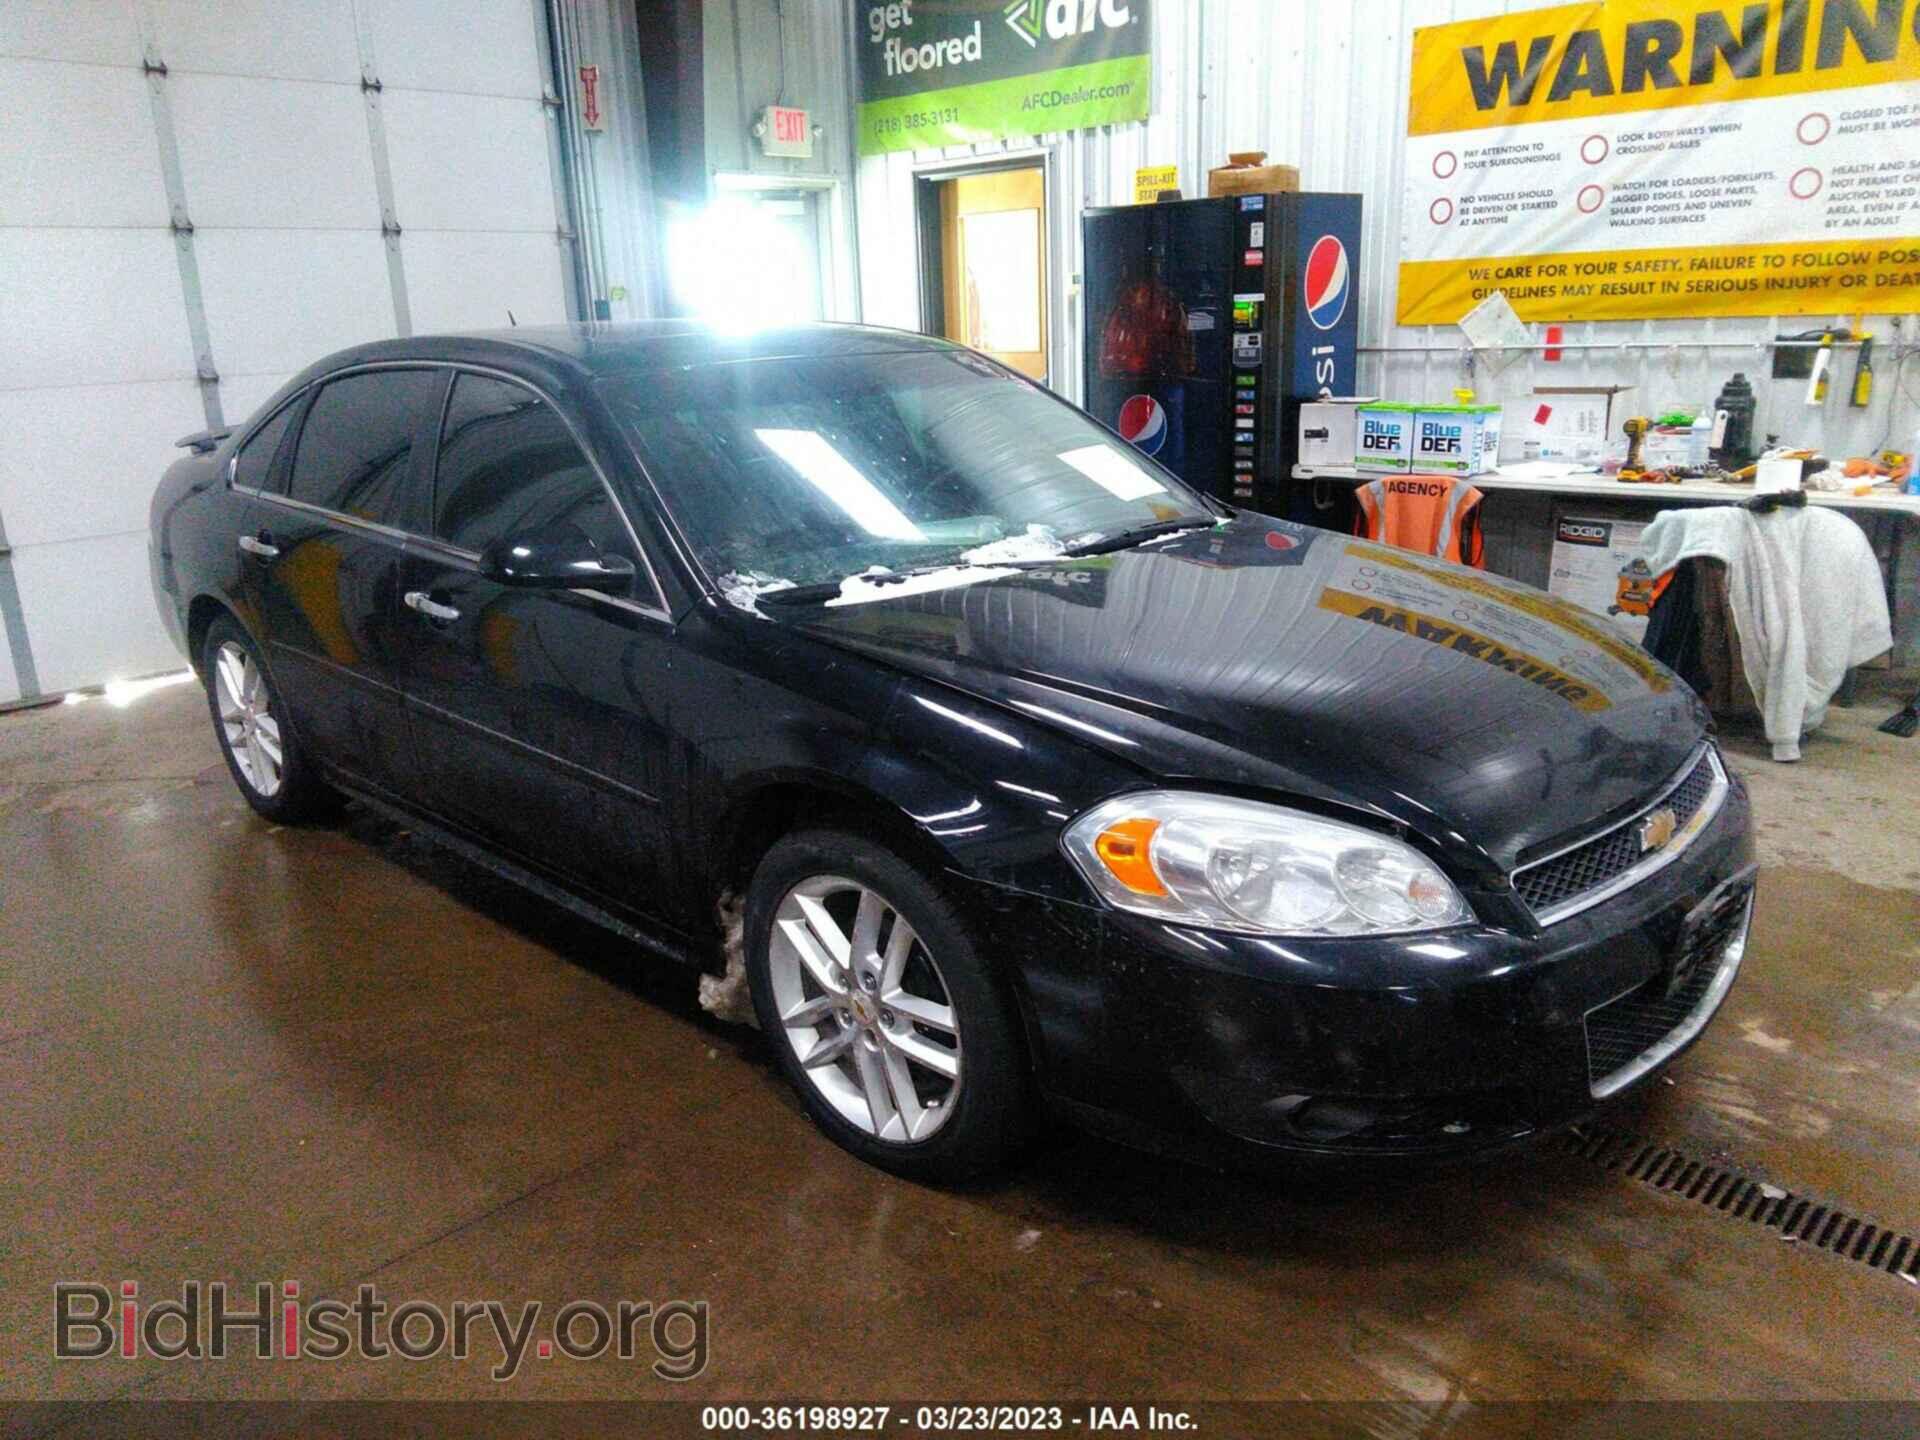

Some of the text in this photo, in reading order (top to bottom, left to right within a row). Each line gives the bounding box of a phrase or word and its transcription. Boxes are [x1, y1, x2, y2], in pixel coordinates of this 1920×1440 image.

[869, 0, 912, 43] get
[884, 20, 982, 76] floored
[1460, 0, 1920, 111] WARNIN
[1840, 108, 1884, 120] CLOSED
[1886, 105, 1908, 116] TOE
[775, 110, 805, 142] EXIT
[1616, 134, 1645, 143] LOOK
[1648, 130, 1675, 140] BOTH
[1708, 123, 1743, 134] WHEN
[1838, 123, 1870, 134] MUST
[1872, 122, 1886, 132] BE
[1481, 144, 1529, 156] ATTENTION
[1532, 143, 1544, 151] TO
[1616, 140, 1701, 155] CROSSING AISLES
[1464, 153, 1561, 170] YOUR SURROUNDINGS
[1832, 164, 1875, 175] HEALTH
[1878, 160, 1905, 172] AND
[1613, 181, 1646, 191] WATCH
[1649, 179, 1668, 188] FOR
[1830, 178, 1855, 188] NOT
[1858, 175, 1899, 186] PERMIT
[1460, 188, 1554, 204] NO VEHICLES SHOULD
[1611, 192, 1650, 204] JAGGED
[1690, 188, 1722, 198] LOOSE
[1828, 188, 1916, 202] AUCTION YARD
[1460, 200, 1558, 216] BE DRIVEN OR STARTED
[1610, 199, 1753, 216] SHARP POINTS AND UNEVEN
[1864, 202, 1894, 213] EVEN
[1897, 201, 1906, 211] IF
[1460, 215, 1508, 226] AT ANYTIME
[1609, 214, 1706, 228] WALKING SURFACES
[1825, 216, 1901, 228] BY AN ADULT
[1468, 268, 1490, 280] WE
[1495, 265, 1532, 280] CARE
[1537, 264, 1568, 278] FOR
[1573, 262, 1618, 276] YOUR
[1690, 256, 1756, 272] FAILURE
[1762, 254, 1786, 268] TO
[1792, 251, 1872, 268] FOLLOW
[1561, 284, 1595, 297] MAY
[1600, 280, 1656, 296] RESULT
[1661, 280, 1680, 294] IN
[1685, 278, 1758, 294] SERIOUS
[1765, 276, 1833, 290] INJURY
[1839, 274, 1868, 288] OR
[1364, 420, 1401, 436] Blue
[1422, 422, 1462, 437] Blue
[1363, 434, 1400, 450] DEF
[1420, 436, 1460, 452] DEF
[1388, 480, 1448, 497] AGENCY
[1560, 523, 1605, 538] RIDGID
